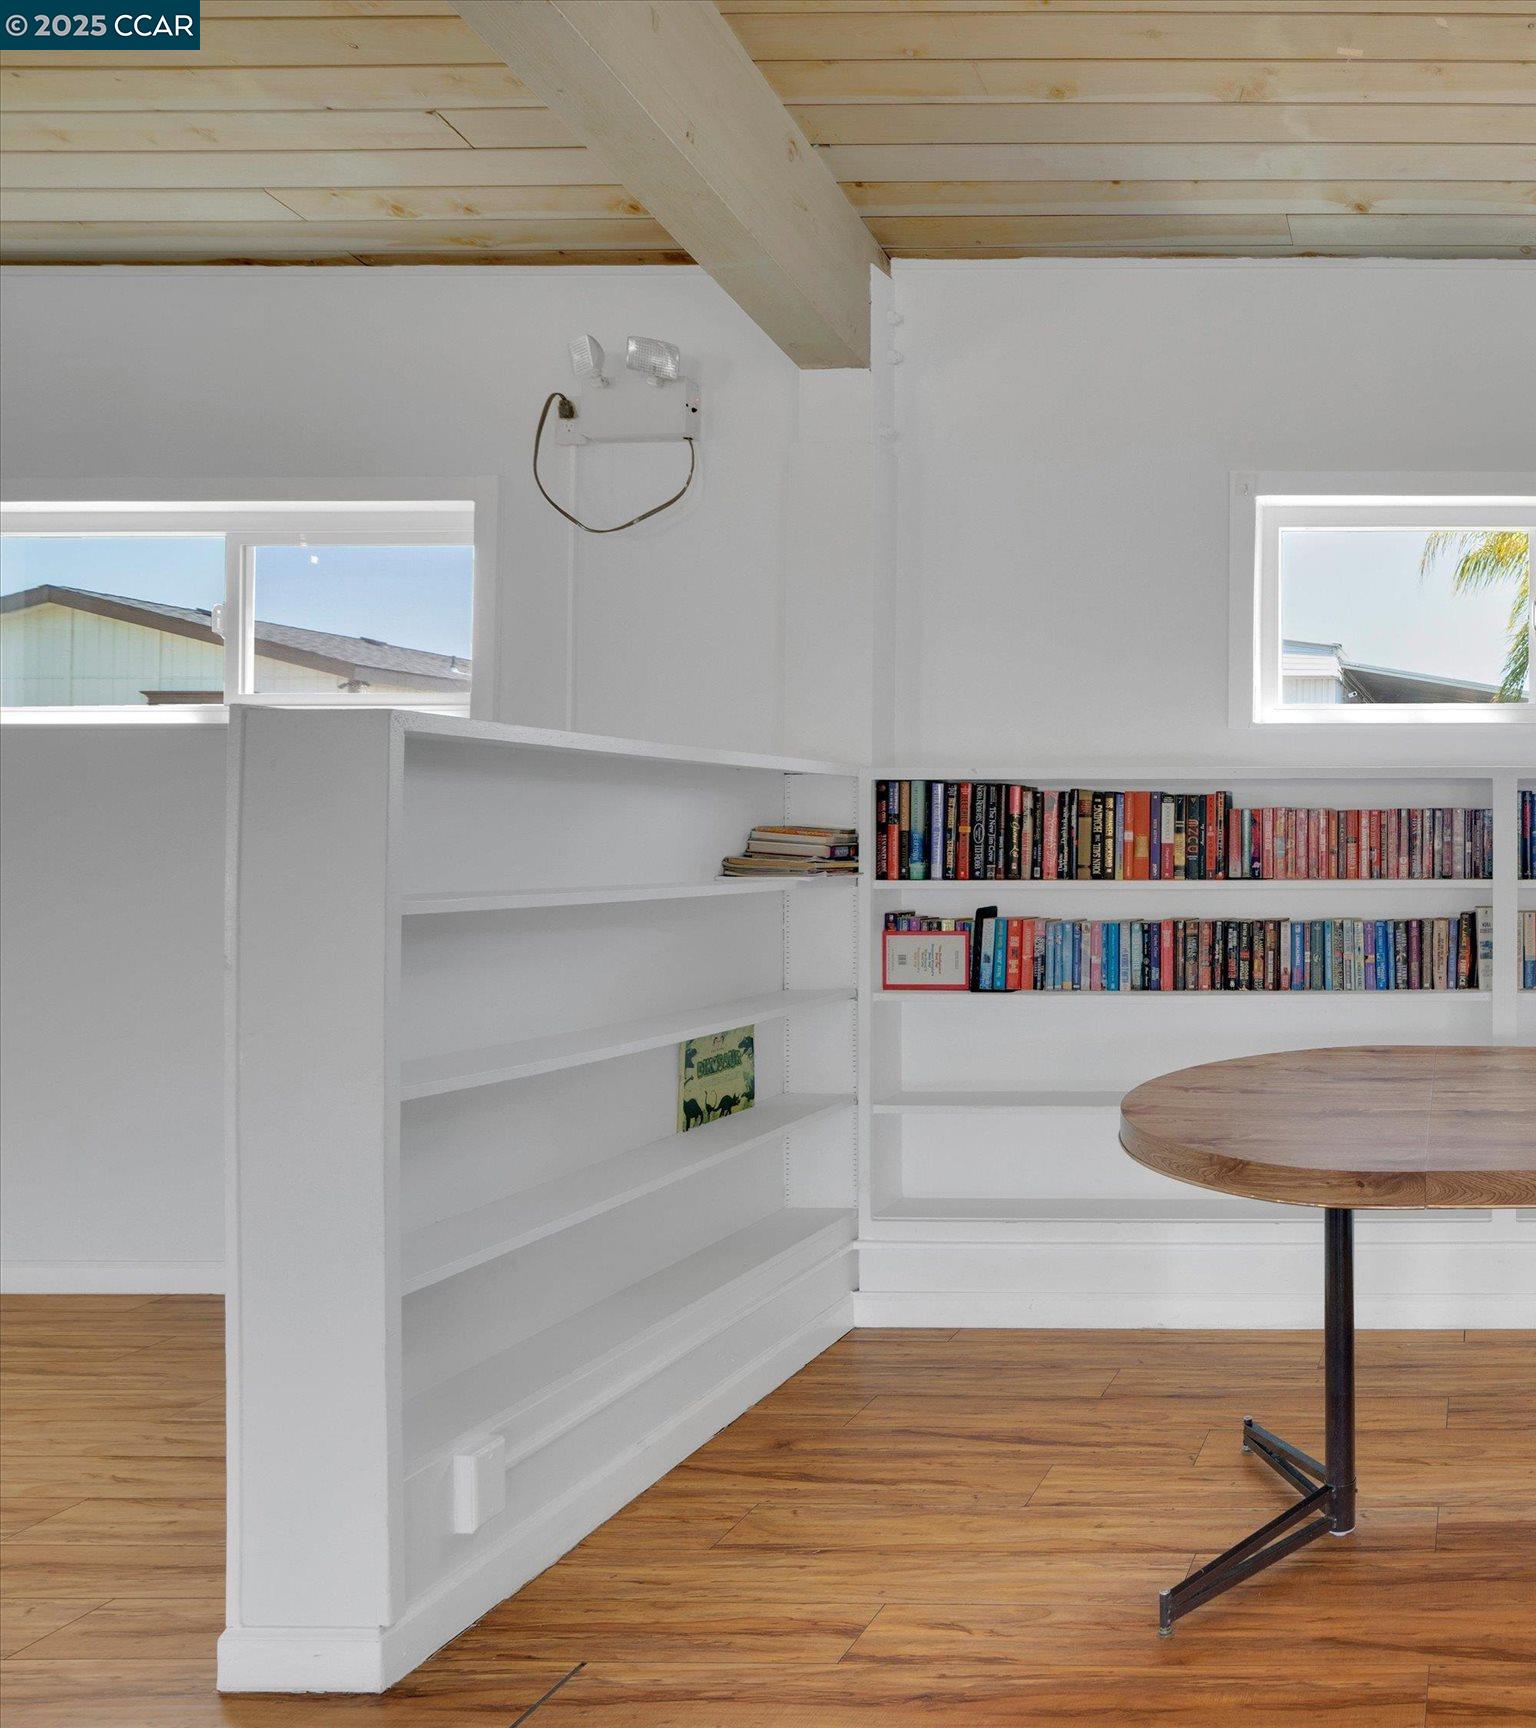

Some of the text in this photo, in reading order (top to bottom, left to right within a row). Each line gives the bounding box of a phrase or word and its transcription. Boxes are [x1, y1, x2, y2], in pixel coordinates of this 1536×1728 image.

[1093, 804, 1102, 833] HOMING
[988, 833, 996, 844] Jim
[1092, 858, 1101, 874] JOHN
